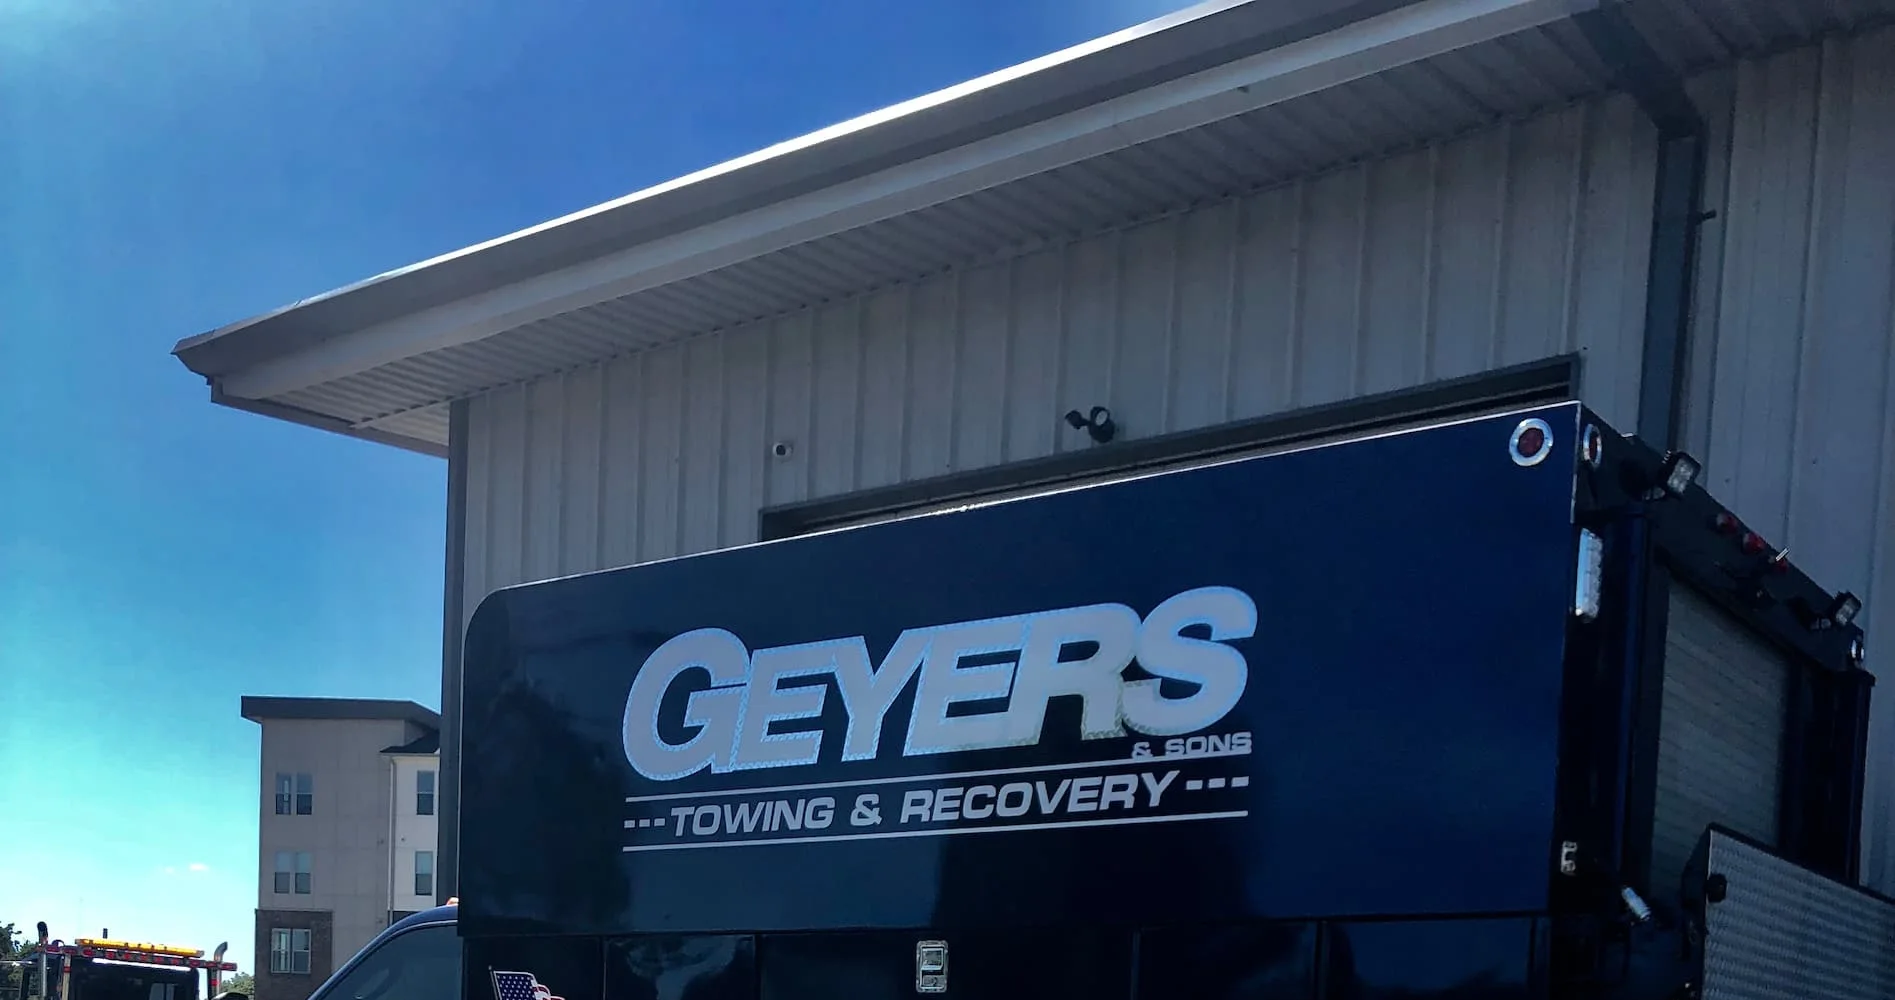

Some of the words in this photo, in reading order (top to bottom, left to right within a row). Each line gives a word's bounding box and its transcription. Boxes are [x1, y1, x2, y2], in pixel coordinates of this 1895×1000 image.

[622, 586, 1258, 781] GEYERS
[1131, 741, 1152, 759] &
[1164, 731, 1252, 756] SONS
[671, 796, 835, 837] TOWING
[850, 794, 882, 827] &
[900, 770, 1180, 824] RECOVERY
